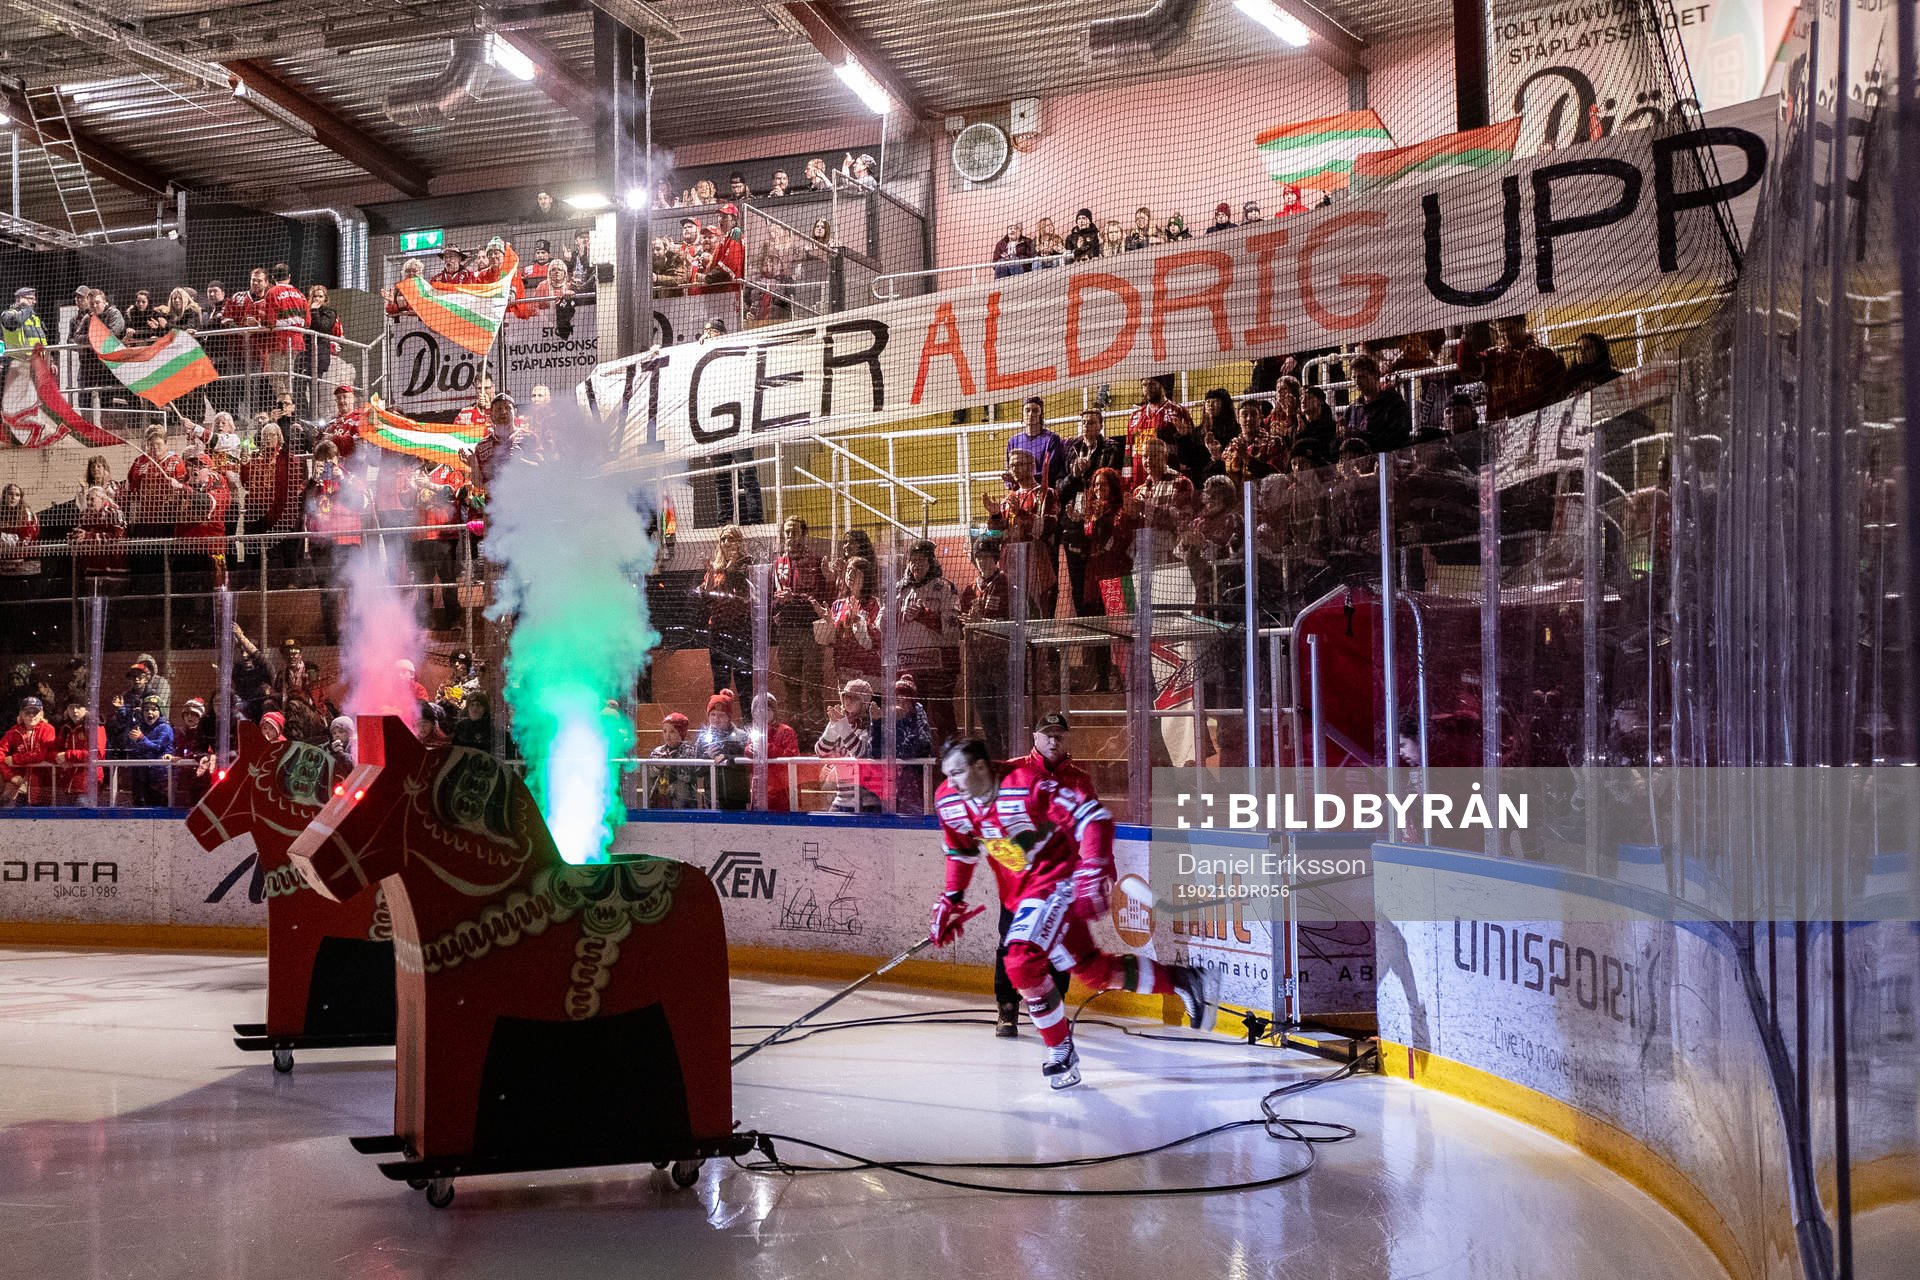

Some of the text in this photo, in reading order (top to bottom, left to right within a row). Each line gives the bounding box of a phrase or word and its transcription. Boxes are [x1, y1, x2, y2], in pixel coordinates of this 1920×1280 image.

[689, 319, 889, 445] GER
[911, 210, 1389, 405] ALDRIG
[1422, 126, 1767, 306] UPP
[397, 331, 493, 396] Diö
[511, 352, 598, 371] STÅPLATSSTÖD
[3, 861, 118, 883] DATA
[54, 885, 118, 898] SINCE 1989
